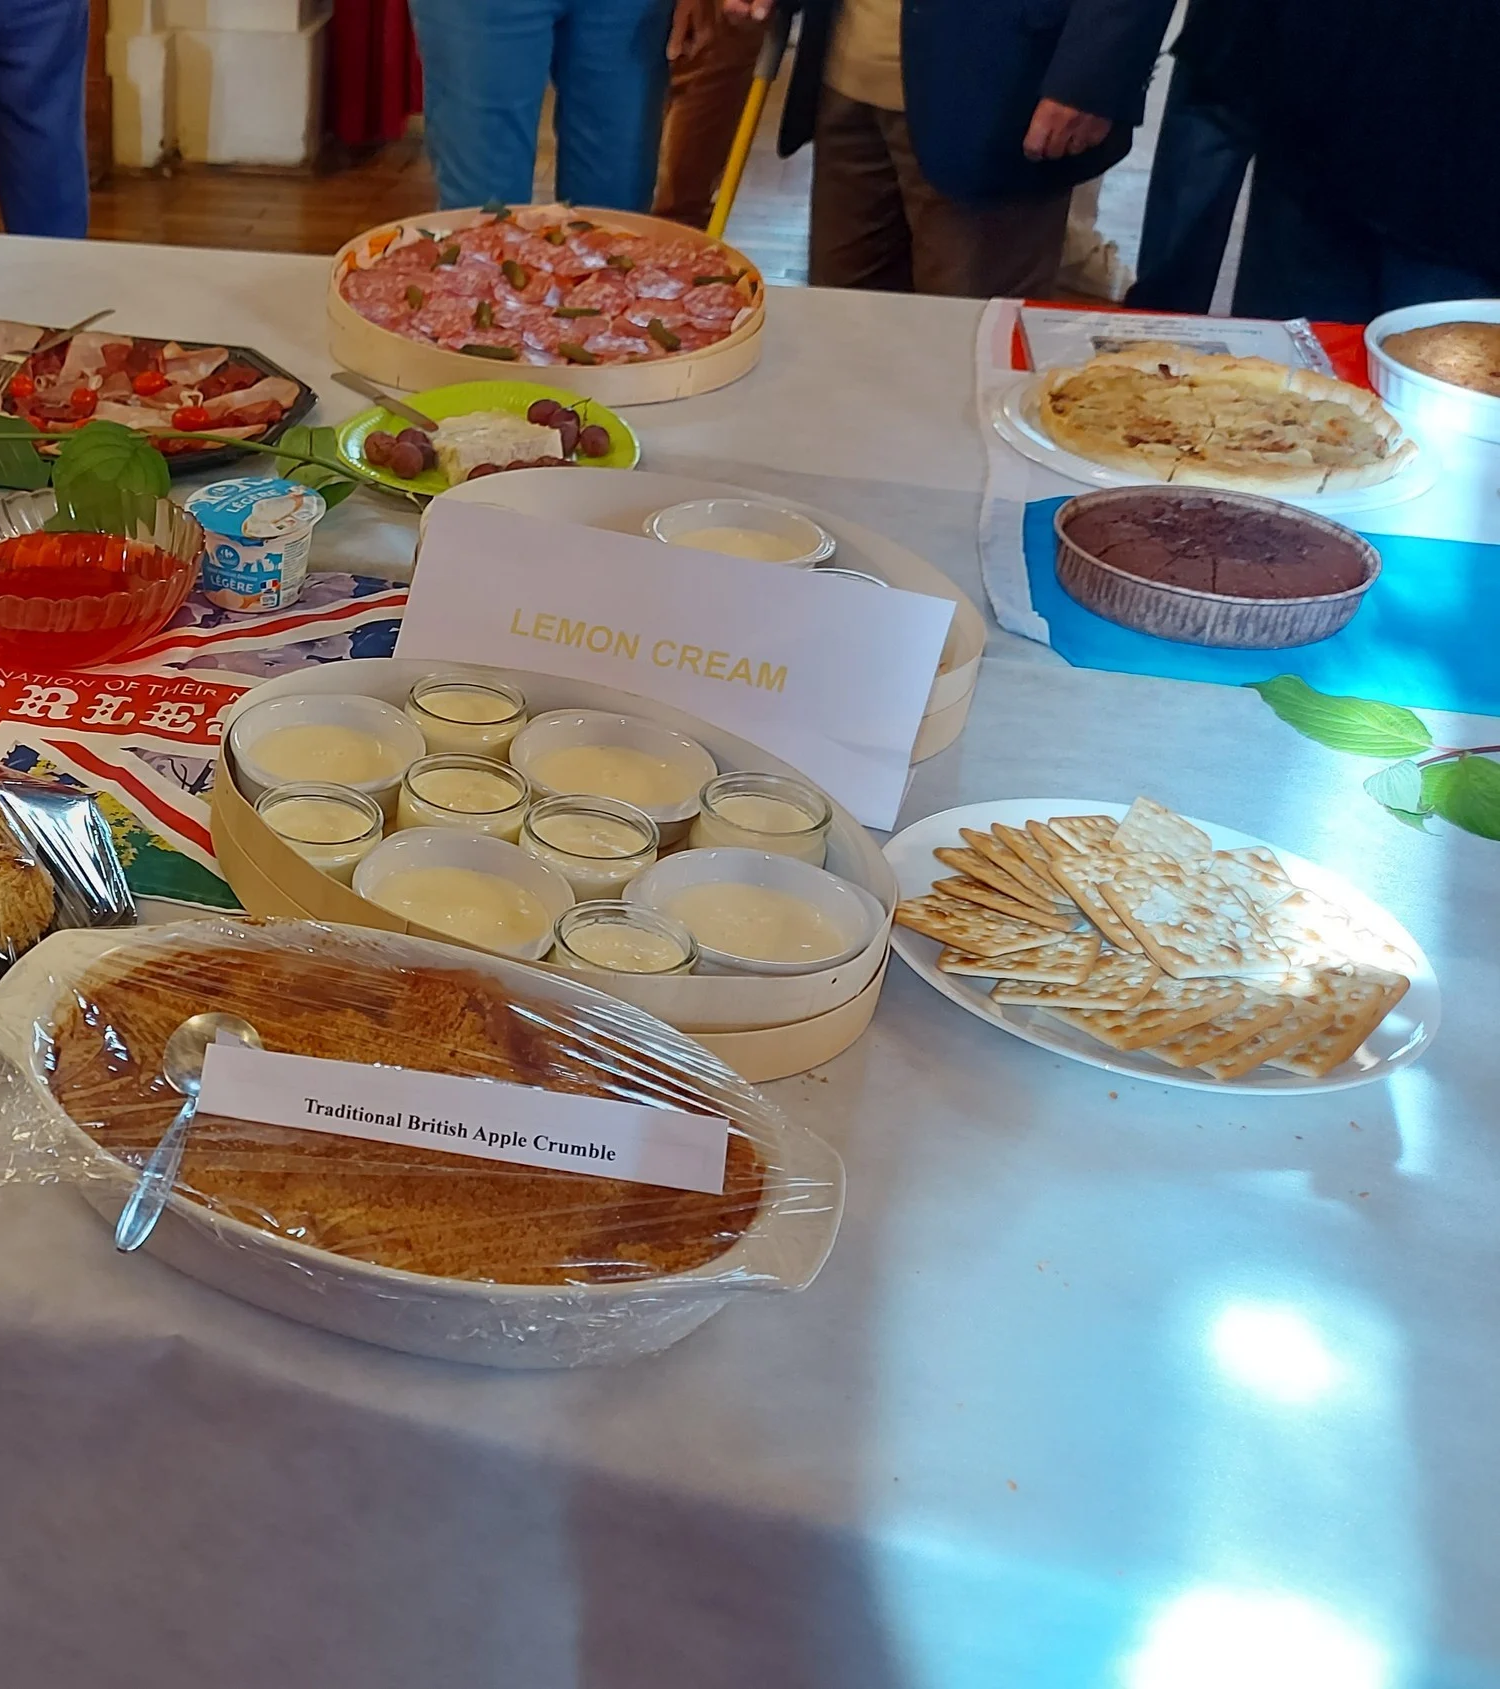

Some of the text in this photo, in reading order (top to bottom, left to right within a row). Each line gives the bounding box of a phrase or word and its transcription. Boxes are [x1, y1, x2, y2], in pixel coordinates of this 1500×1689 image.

[210, 573, 254, 594] LÉGÈRE
[510, 608, 788, 693] LEMON CREAM
[105, 679, 141, 692] OF
[148, 683, 216, 698] THEIR
[304, 1098, 616, 1161] Traditional British Apple Crumble
